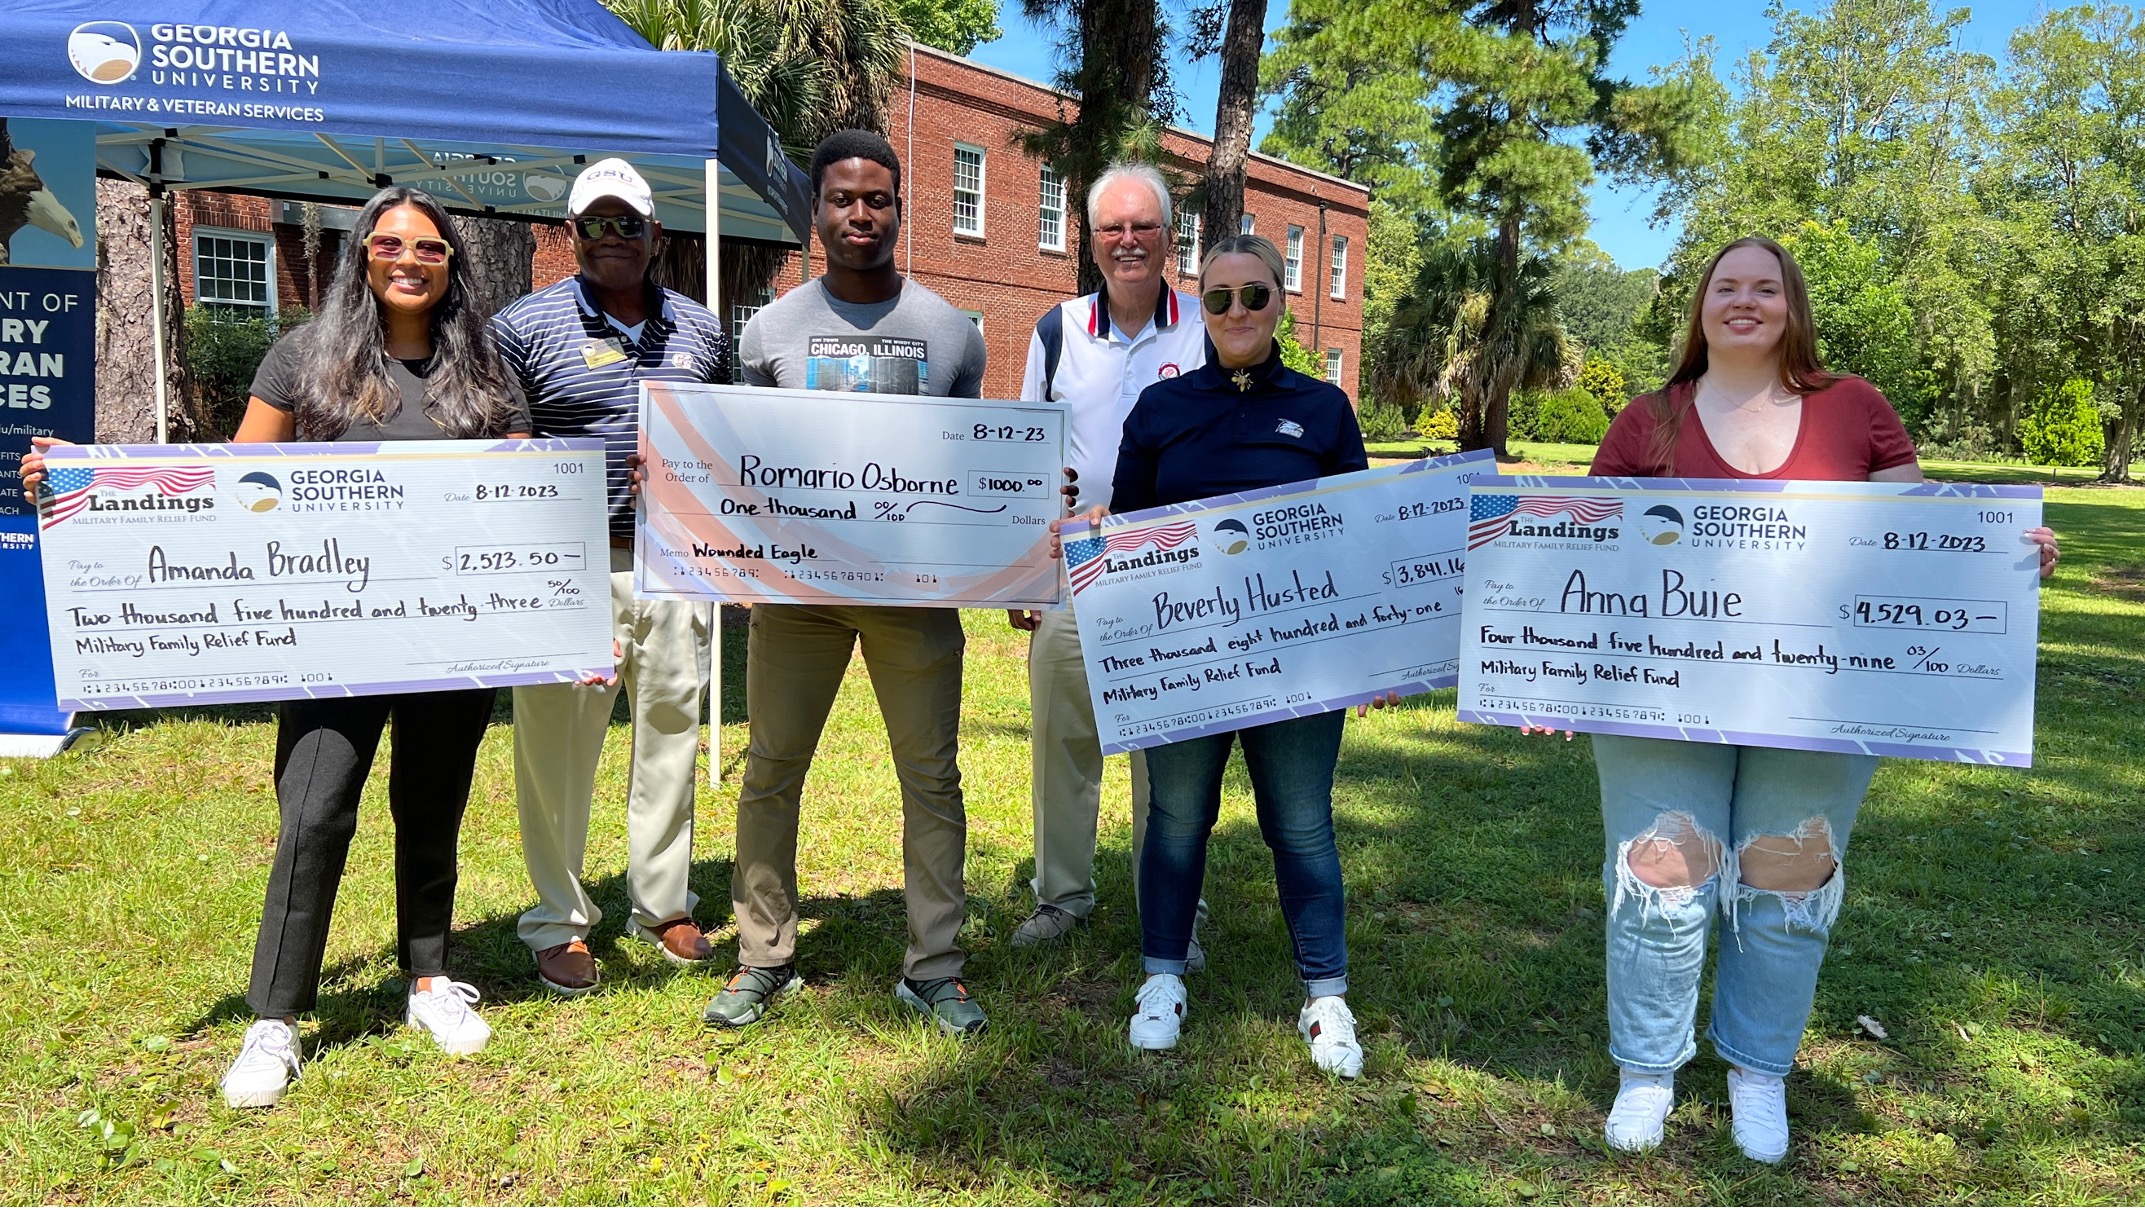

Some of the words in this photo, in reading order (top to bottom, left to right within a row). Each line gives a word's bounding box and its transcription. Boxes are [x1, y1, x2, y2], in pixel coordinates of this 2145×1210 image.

[151, 23, 293, 51] GEORGIA
[151, 45, 320, 78] SOUTHERN
[152, 71, 319, 95] UNIVERSITY
[65, 94, 144, 111] MILITARY
[147, 98, 160, 111] &
[163, 98, 242, 117] VETERAN
[243, 103, 324, 122] SERVICES
[586, 169, 633, 183] GSU
[42, 293, 78, 312] OF
[2, 318, 49, 344] RY
[811, 343, 870, 356] CHICAGO,
[874, 344, 925, 359] ILLINOIS
[942, 430, 965, 440] Date
[973, 423, 1045, 441] 8-12-23
[553, 462, 585, 474] 1001
[661, 458, 680, 470] Pay
[682, 461, 694, 470] to
[696, 460, 713, 470] the
[290, 469, 386, 485] GEORGIA
[665, 472, 696, 483] Order
[699, 474, 710, 484] of
[740, 454, 855, 489] Romario
[861, 462, 960, 495] Osborne
[291, 485, 404, 501] SOUTHERN
[443, 492, 470, 503] Date
[88, 493, 215, 513] Landings
[292, 501, 404, 513] UNIVERSITY
[720, 498, 761, 516] One
[763, 497, 857, 520] thousand
[1398, 497, 1465, 520] 8-12-2023
[72, 516, 118, 525] MILITARY
[120, 515, 155, 524] FAMILY
[157, 514, 187, 523] RELIEF
[190, 513, 217, 523] FUND
[1012, 515, 1046, 525] Dollars
[1253, 503, 1327, 526] GEORGIA
[1375, 513, 1395, 523] Date
[1520, 516, 1534, 524] THE
[1693, 505, 1789, 522] GEORGIA
[1977, 511, 2014, 524] 1001
[1255, 513, 1344, 541] SOUTHERN
[1509, 520, 1619, 542] Landings
[1692, 522, 1807, 539] SOUTHERN
[1258, 527, 1344, 551] UNIVERSITY
[1494, 540, 1533, 549] MILITARY
[1533, 541, 1565, 550] FAMILY
[1566, 542, 1593, 551] RELIEF
[1595, 543, 1619, 552] FUND
[1692, 539, 1806, 551] UNIVERSITY
[1849, 536, 1877, 547] Date
[1883, 532, 1986, 552] 8-12-2023
[660, 548, 689, 558] Memo
[692, 543, 764, 559] Wounded
[771, 544, 818, 564] Eagle
[1104, 547, 1200, 574] Landings
[68, 559, 94, 573] Pay
[94, 561, 104, 569] to
[148, 544, 255, 584] Amanda
[266, 537, 371, 593] Bradley
[69, 575, 88, 588] the
[89, 575, 123, 587] Order
[124, 574, 143, 589] Of
[1095, 575, 1130, 588] MILITARY
[1130, 571, 1157, 582] FAMILY
[1158, 566, 1180, 577] RELIEF
[1182, 562, 1203, 572] FUND
[1484, 579, 1504, 591] Pay
[1505, 582, 1514, 590] to
[548, 597, 585, 608] Dollars
[1152, 586, 1240, 630] Beverly
[1244, 570, 1339, 611] Husted
[1561, 569, 1648, 618] Anna
[1661, 569, 1743, 619] Buie
[1483, 596, 1498, 606] the
[1499, 596, 1527, 607] Order
[1529, 598, 1547, 611] Of
[65, 606, 111, 628] Two
[118, 602, 219, 625] thousand
[233, 598, 273, 622] five
[278, 598, 362, 622] hundred
[371, 599, 406, 618] and
[1096, 617, 1115, 628] Pay
[1115, 616, 1124, 624] to
[1098, 655, 1145, 675] Three
[1148, 636, 1218, 663] thousand
[1227, 632, 1264, 652] eight
[1269, 619, 1340, 643] hundred
[1345, 613, 1368, 629] and
[1372, 601, 1442, 624] forty-one
[1099, 632, 1113, 642] the
[1114, 628, 1138, 640] Order
[1140, 623, 1154, 638] Of
[75, 636, 144, 657] Military
[149, 634, 200, 656] Family
[203, 631, 250, 650] Relief
[254, 627, 298, 647] Fund
[1480, 625, 1516, 645] Four
[1522, 626, 1598, 650] thousand
[1607, 631, 1643, 653] five
[1648, 635, 1724, 660] hundred
[1732, 645, 1762, 661] and
[1771, 639, 1896, 674] twenty-nine
[79, 668, 99, 679] For
[446, 660, 503, 674] Authorized
[503, 659, 550, 672] Signature
[1401, 661, 1447, 681] Authorized
[1481, 659, 1537, 682] Military
[1542, 661, 1588, 685] Family
[1593, 664, 1638, 683] Relief
[1643, 668, 1680, 688] Fund
[1956, 663, 2001, 676] Dollars
[1102, 684, 1157, 705] Military
[1160, 676, 1201, 693] Family
[1203, 667, 1241, 685] Relief
[1245, 657, 1282, 677] Fund
[1478, 682, 1496, 693] For
[1114, 713, 1131, 723] For
[1829, 723, 1894, 739] Authorized
[1894, 727, 1950, 743] Signature
